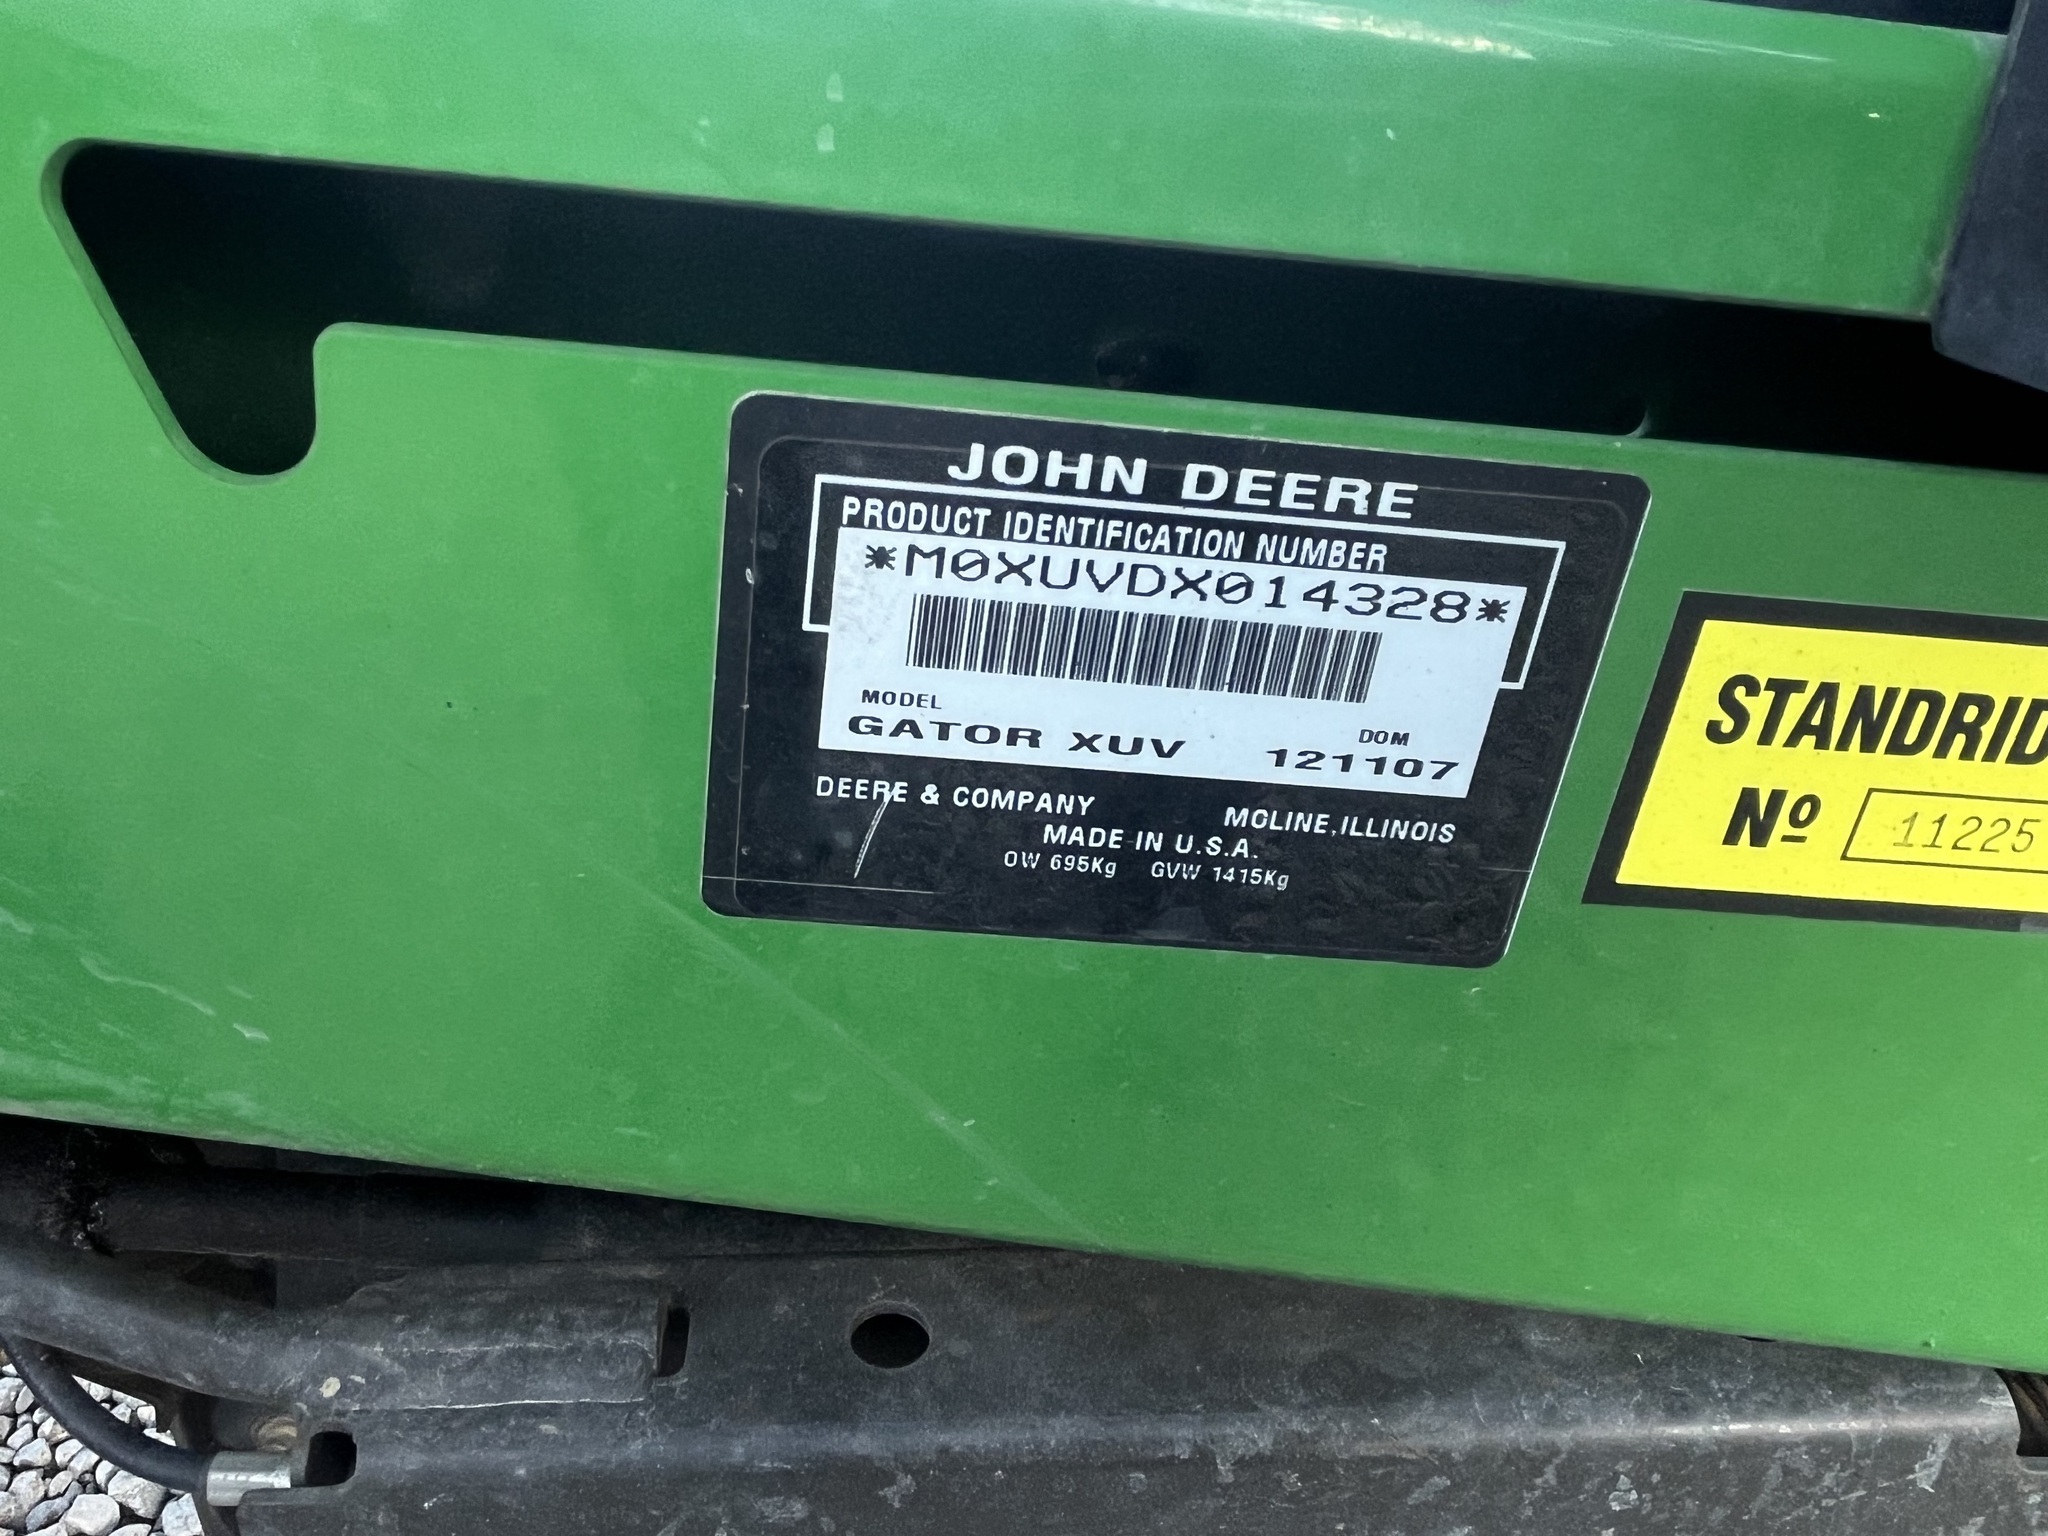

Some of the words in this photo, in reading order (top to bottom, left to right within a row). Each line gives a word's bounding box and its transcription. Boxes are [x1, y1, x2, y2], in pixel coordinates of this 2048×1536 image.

[948, 443, 1147, 494] JOHN
[1181, 463, 1418, 518] DEERE
[842, 496, 991, 536] PRODUCT
[1003, 511, 1245, 558] IDENTIFICATION
[1255, 533, 1388, 572] NUMBER
[861, 689, 942, 710] MODEL
[848, 715, 1042, 748] GATOR
[1068, 732, 1186, 759] XUV
[1359, 729, 1410, 747] DOM
[1266, 748, 1459, 781] 121107
[816, 776, 908, 803] DEERE
[920, 784, 940, 805] &
[953, 787, 1095, 816] COMPANY
[1043, 824, 1124, 850] MADE
[1136, 831, 1163, 852] IN
[1175, 835, 1258, 860] U.S.A.
[1893, 811, 2041, 853] 11225
[1050, 854, 1117, 878] 695Kg
[1151, 861, 1201, 881] GVW
[1212, 867, 1289, 890] 1415Kg
